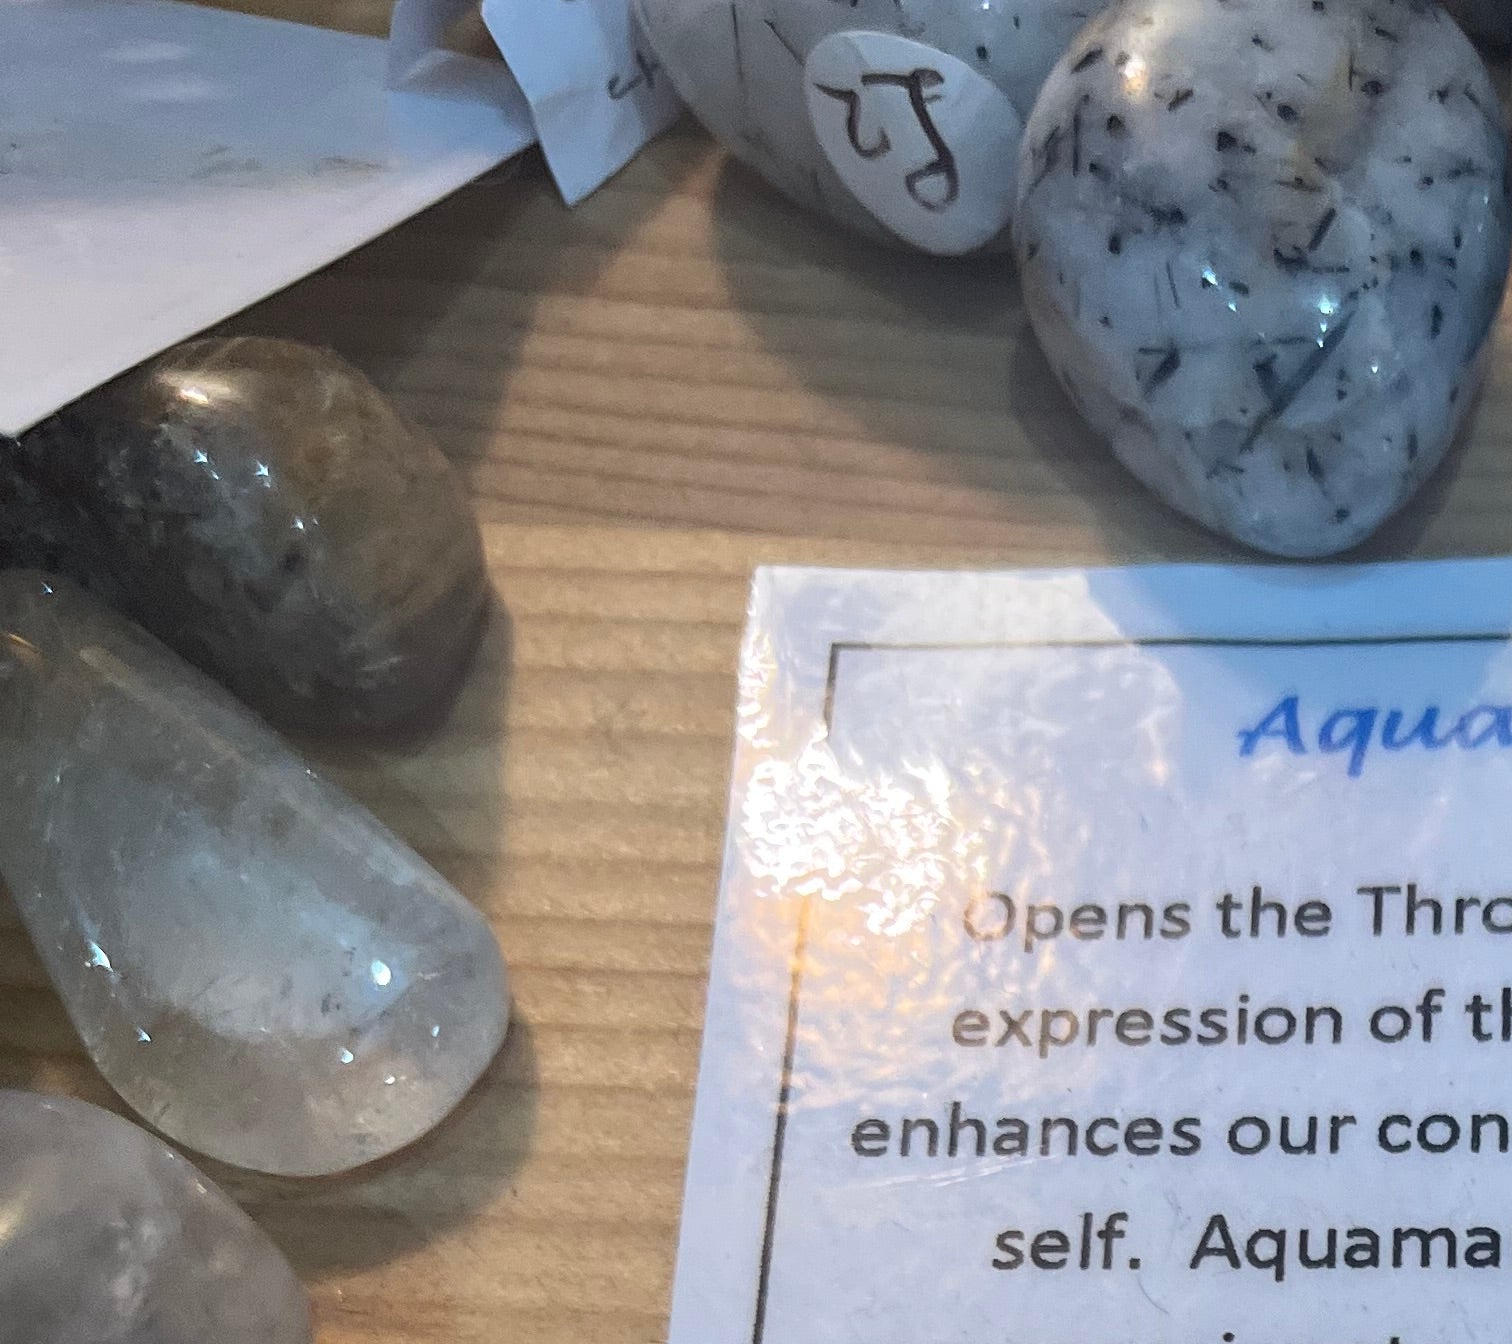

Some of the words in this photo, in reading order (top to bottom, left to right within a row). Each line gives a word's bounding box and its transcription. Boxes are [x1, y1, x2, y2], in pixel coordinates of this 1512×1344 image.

[962, 891, 1192, 955] Opens
[1214, 884, 1333, 941] the
[951, 993, 1344, 1060] expression
[1367, 987, 1446, 1045] of
[849, 1100, 1202, 1159] enhances
[1225, 1114, 1358, 1158] our
[990, 1211, 1142, 1272] self.
